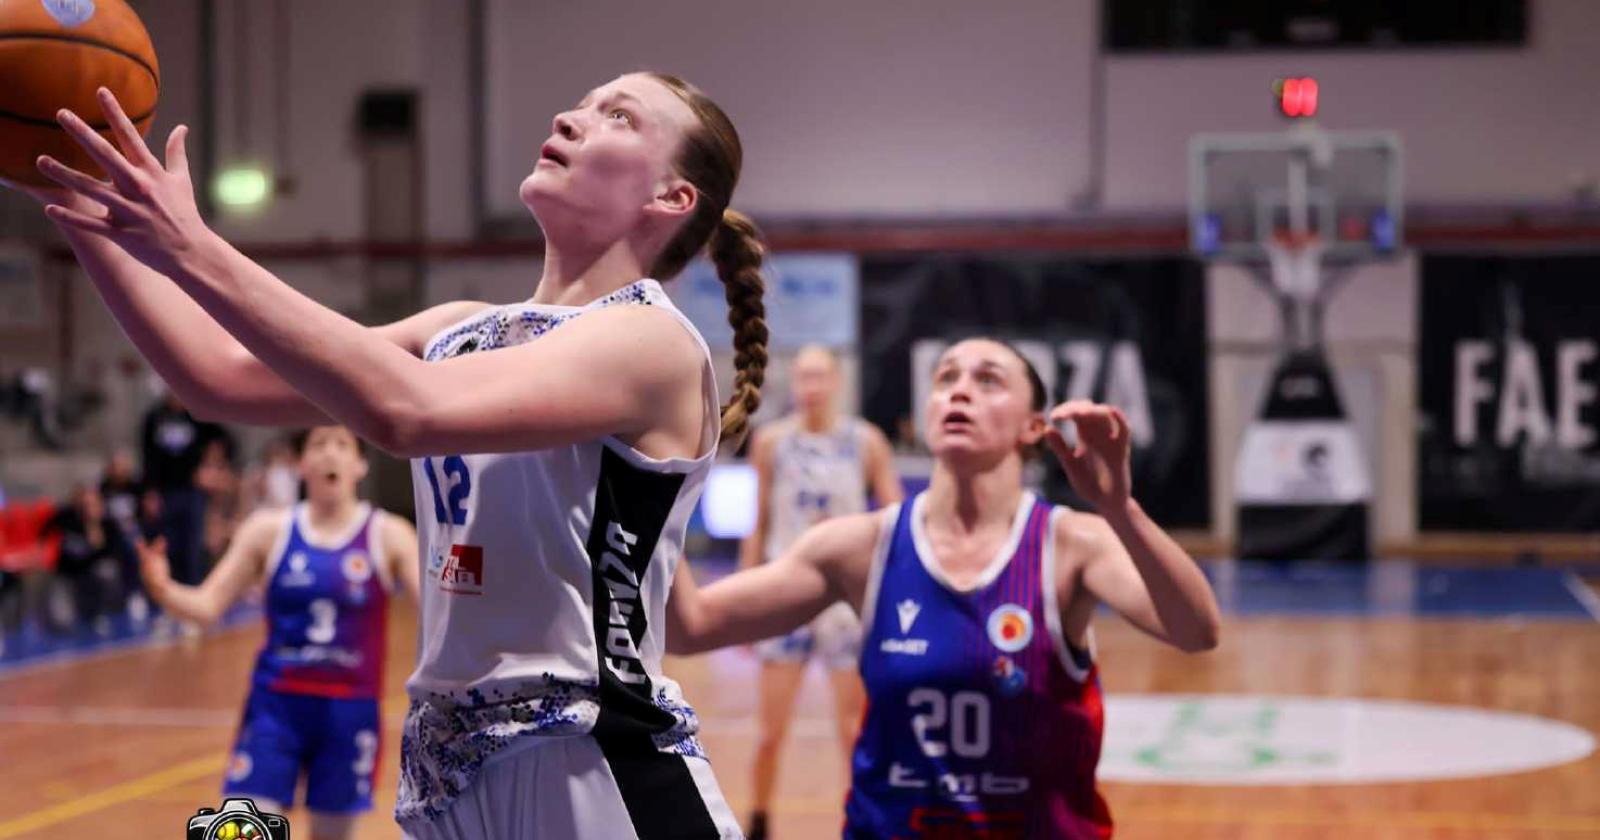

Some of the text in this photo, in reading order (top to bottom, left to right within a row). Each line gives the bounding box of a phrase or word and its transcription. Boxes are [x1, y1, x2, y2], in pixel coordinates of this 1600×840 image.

[1455, 339, 1598, 446] FAE
[424, 455, 472, 525] 12
[307, 599, 336, 644] 3
[907, 688, 991, 758] 20
